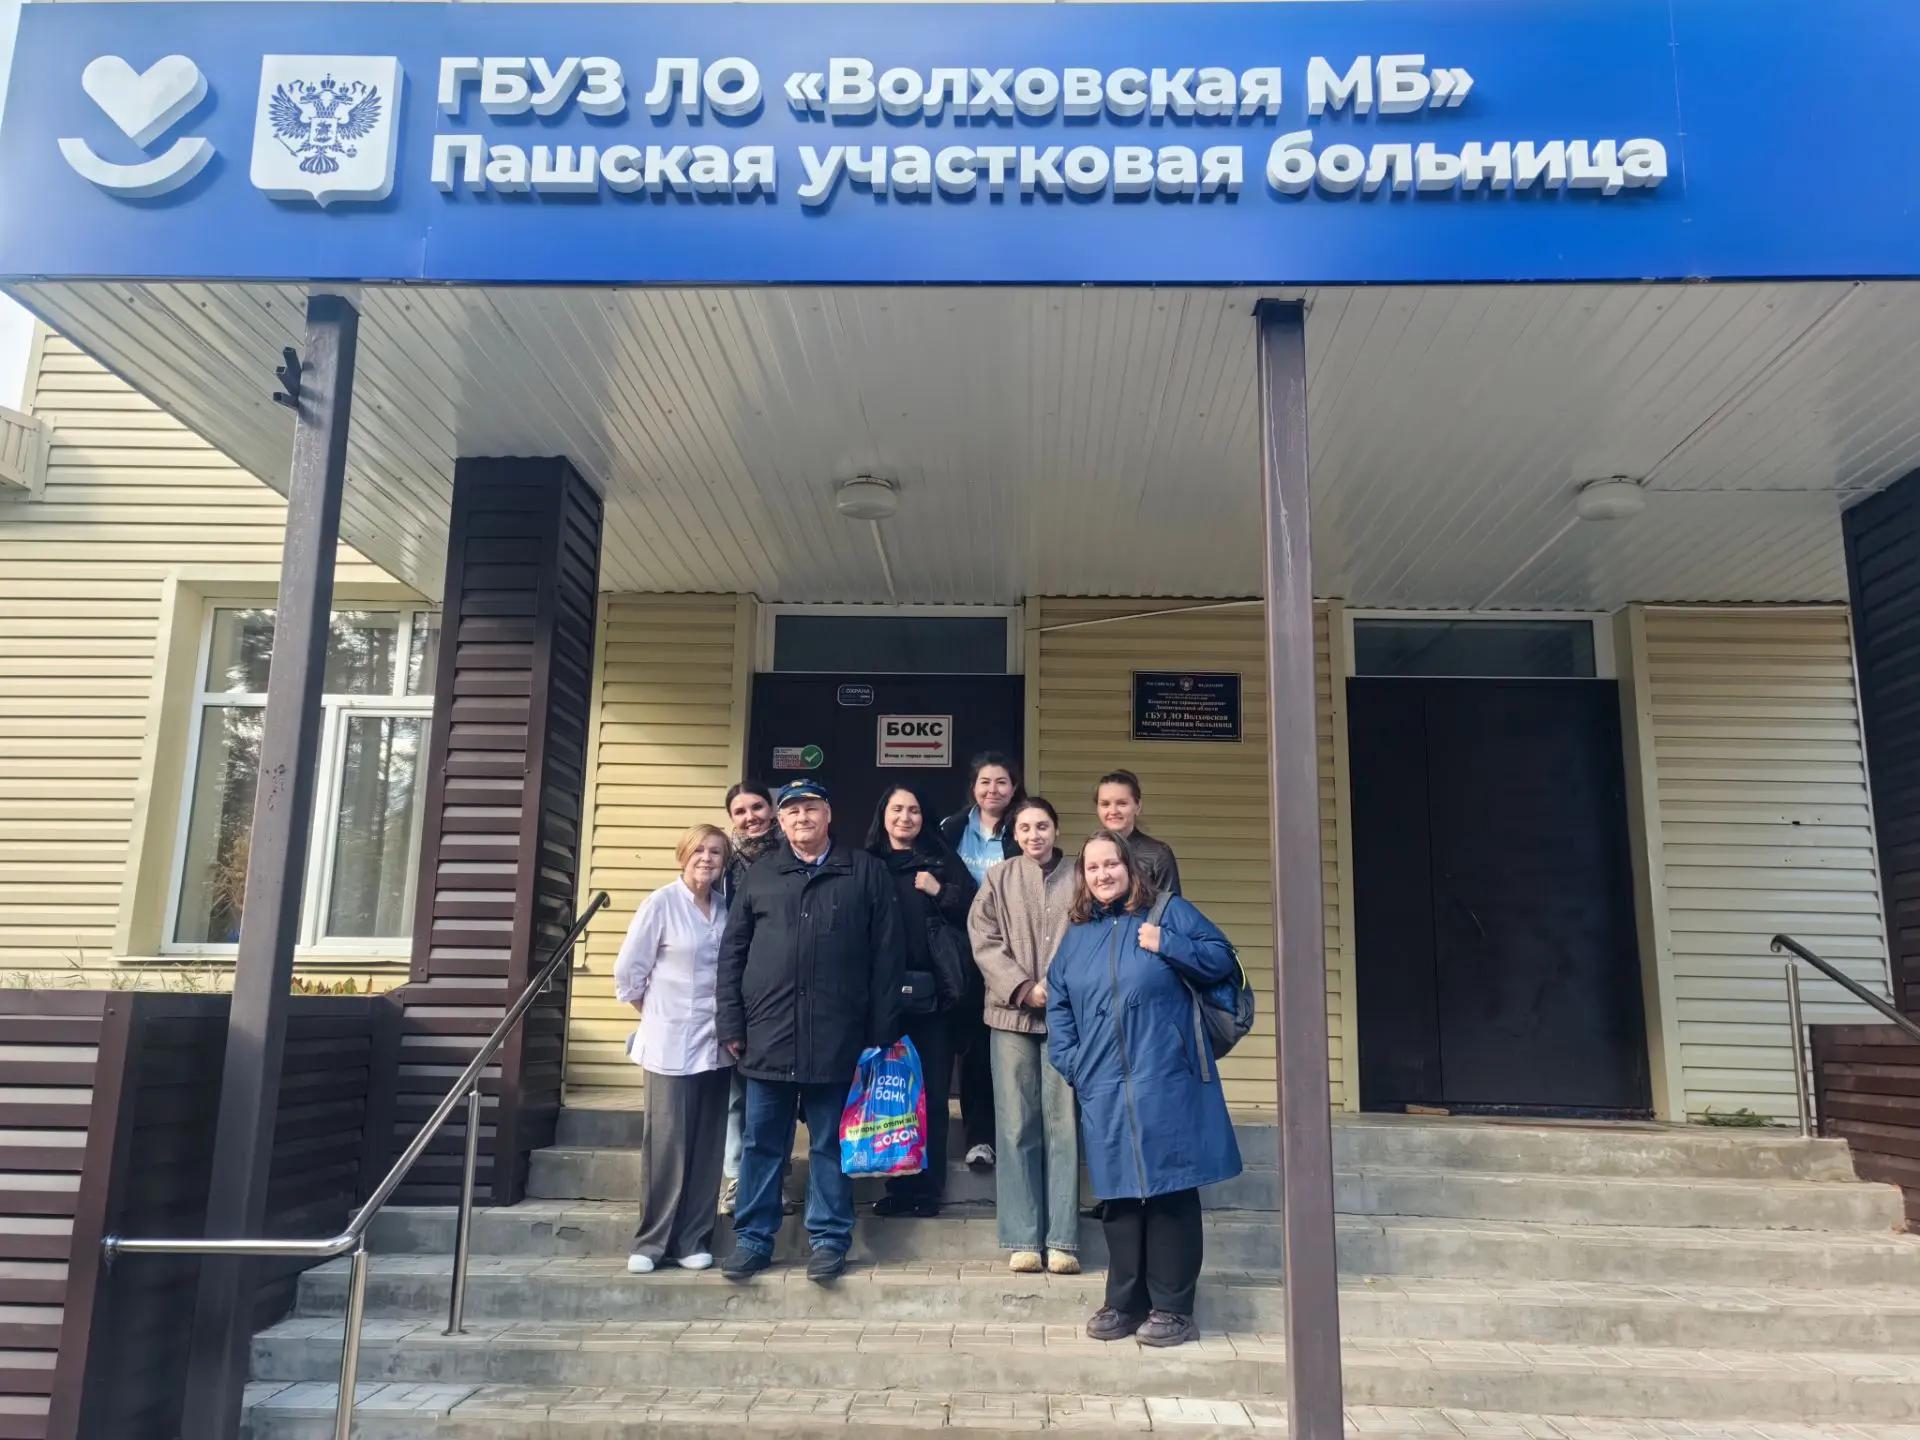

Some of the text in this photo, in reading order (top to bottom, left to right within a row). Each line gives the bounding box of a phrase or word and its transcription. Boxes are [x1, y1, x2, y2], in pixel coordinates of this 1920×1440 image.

[437, 54, 1474, 117] ГБУЗ ЛО «Волховская МБ»
[431, 129, 1668, 206] Пашская участковая больница
[886, 721, 943, 737] БОКС
[877, 1075, 906, 1089] ozon
[875, 1086, 905, 1103] банк
[882, 1127, 918, 1145] OZON
